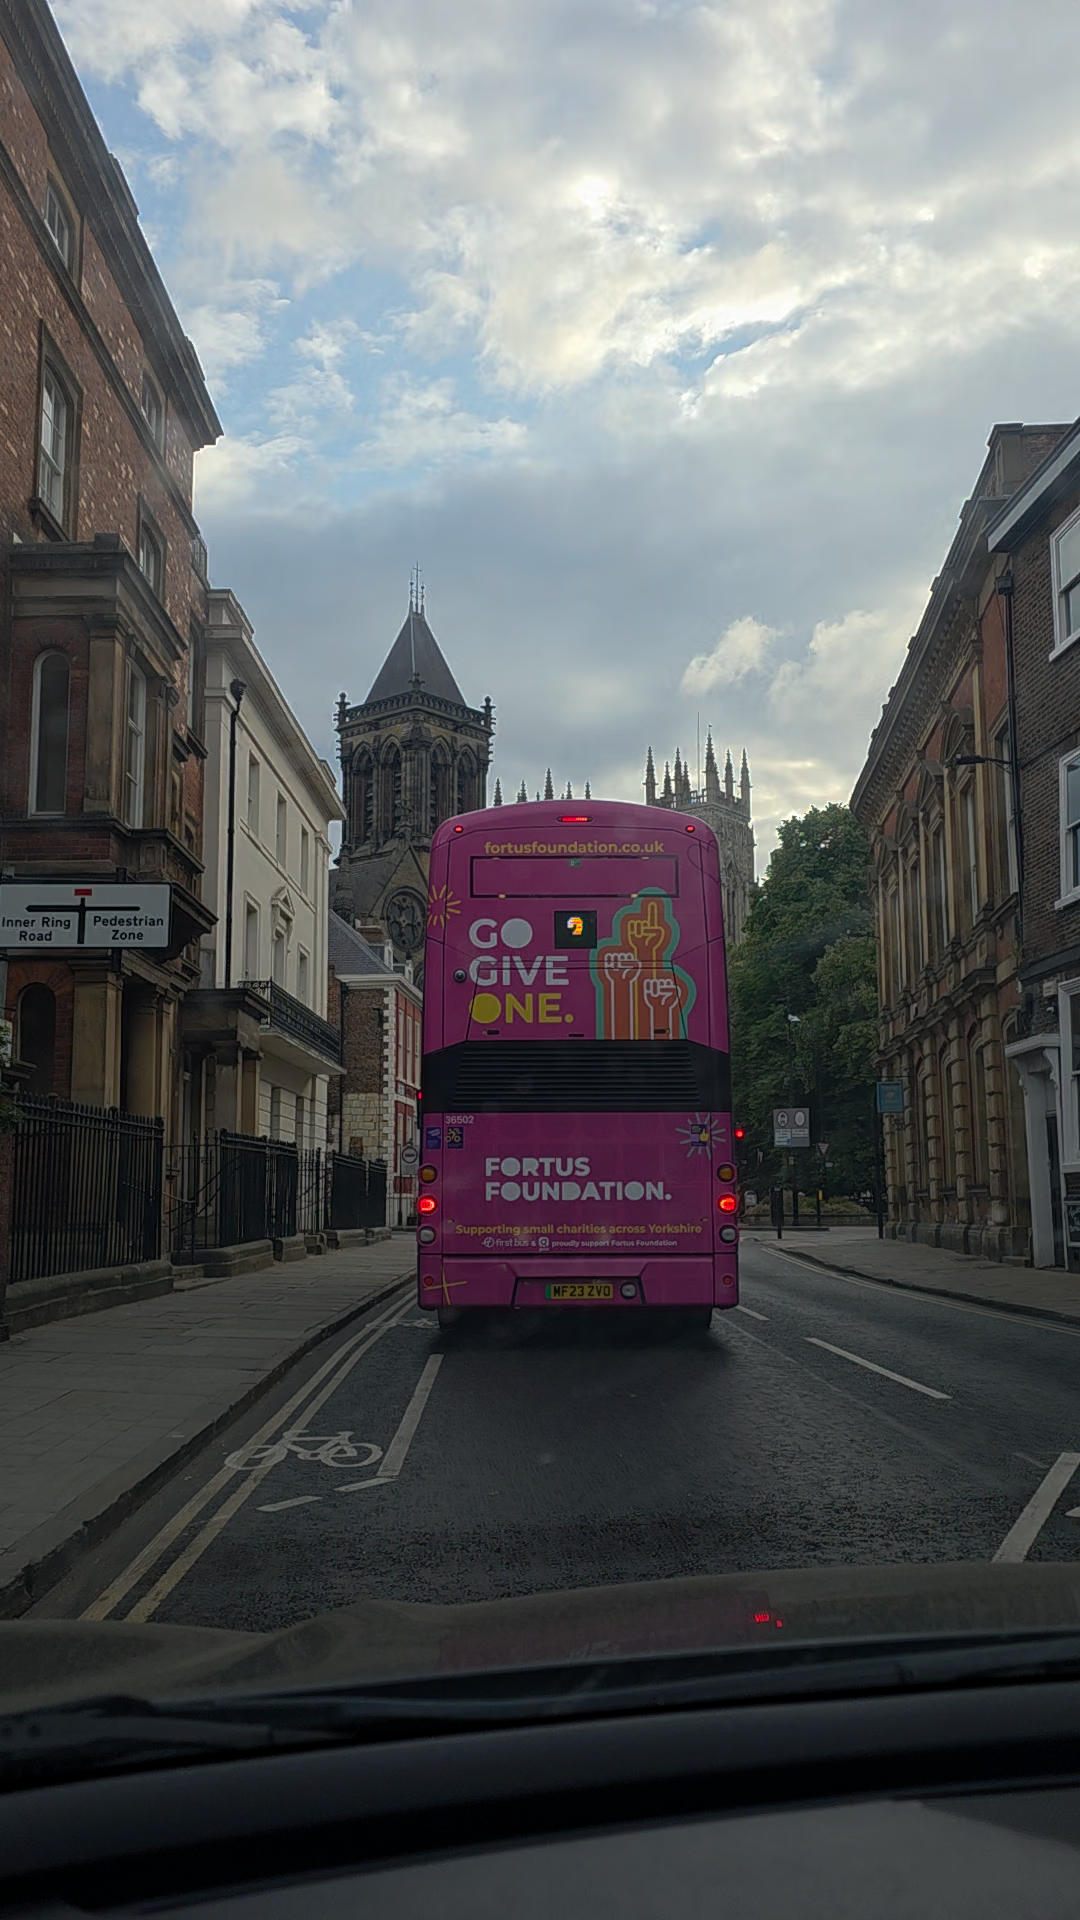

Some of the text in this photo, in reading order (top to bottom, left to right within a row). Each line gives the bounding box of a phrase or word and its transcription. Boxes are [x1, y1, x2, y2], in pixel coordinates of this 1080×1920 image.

[484, 840, 665, 855] fortusfoundation.co.uk
[1, 916, 71, 930] Inner Ring
[93, 915, 164, 927] Pedestrian
[18, 930, 53, 941] Road
[111, 929, 144, 940] Zone
[468, 918, 533, 949] GO
[468, 955, 570, 986] GIVE
[468, 992, 574, 1024] ONE.
[445, 1115, 475, 1125] 36502
[485, 1157, 591, 1177] FORTUS
[485, 1180, 672, 1202] FOUNDATION.
[455, 1222, 703, 1236] Supporting small charities across Yorkshire
[496, 1237, 512, 1247] first
[514, 1237, 529, 1247] bus
[551, 1239, 580, 1249] proudly
[581, 1239, 609, 1248] support
[611, 1239, 634, 1247] Fortus
[636, 1239, 678, 1247] Foundation
[553, 1285, 585, 1297] MF23
